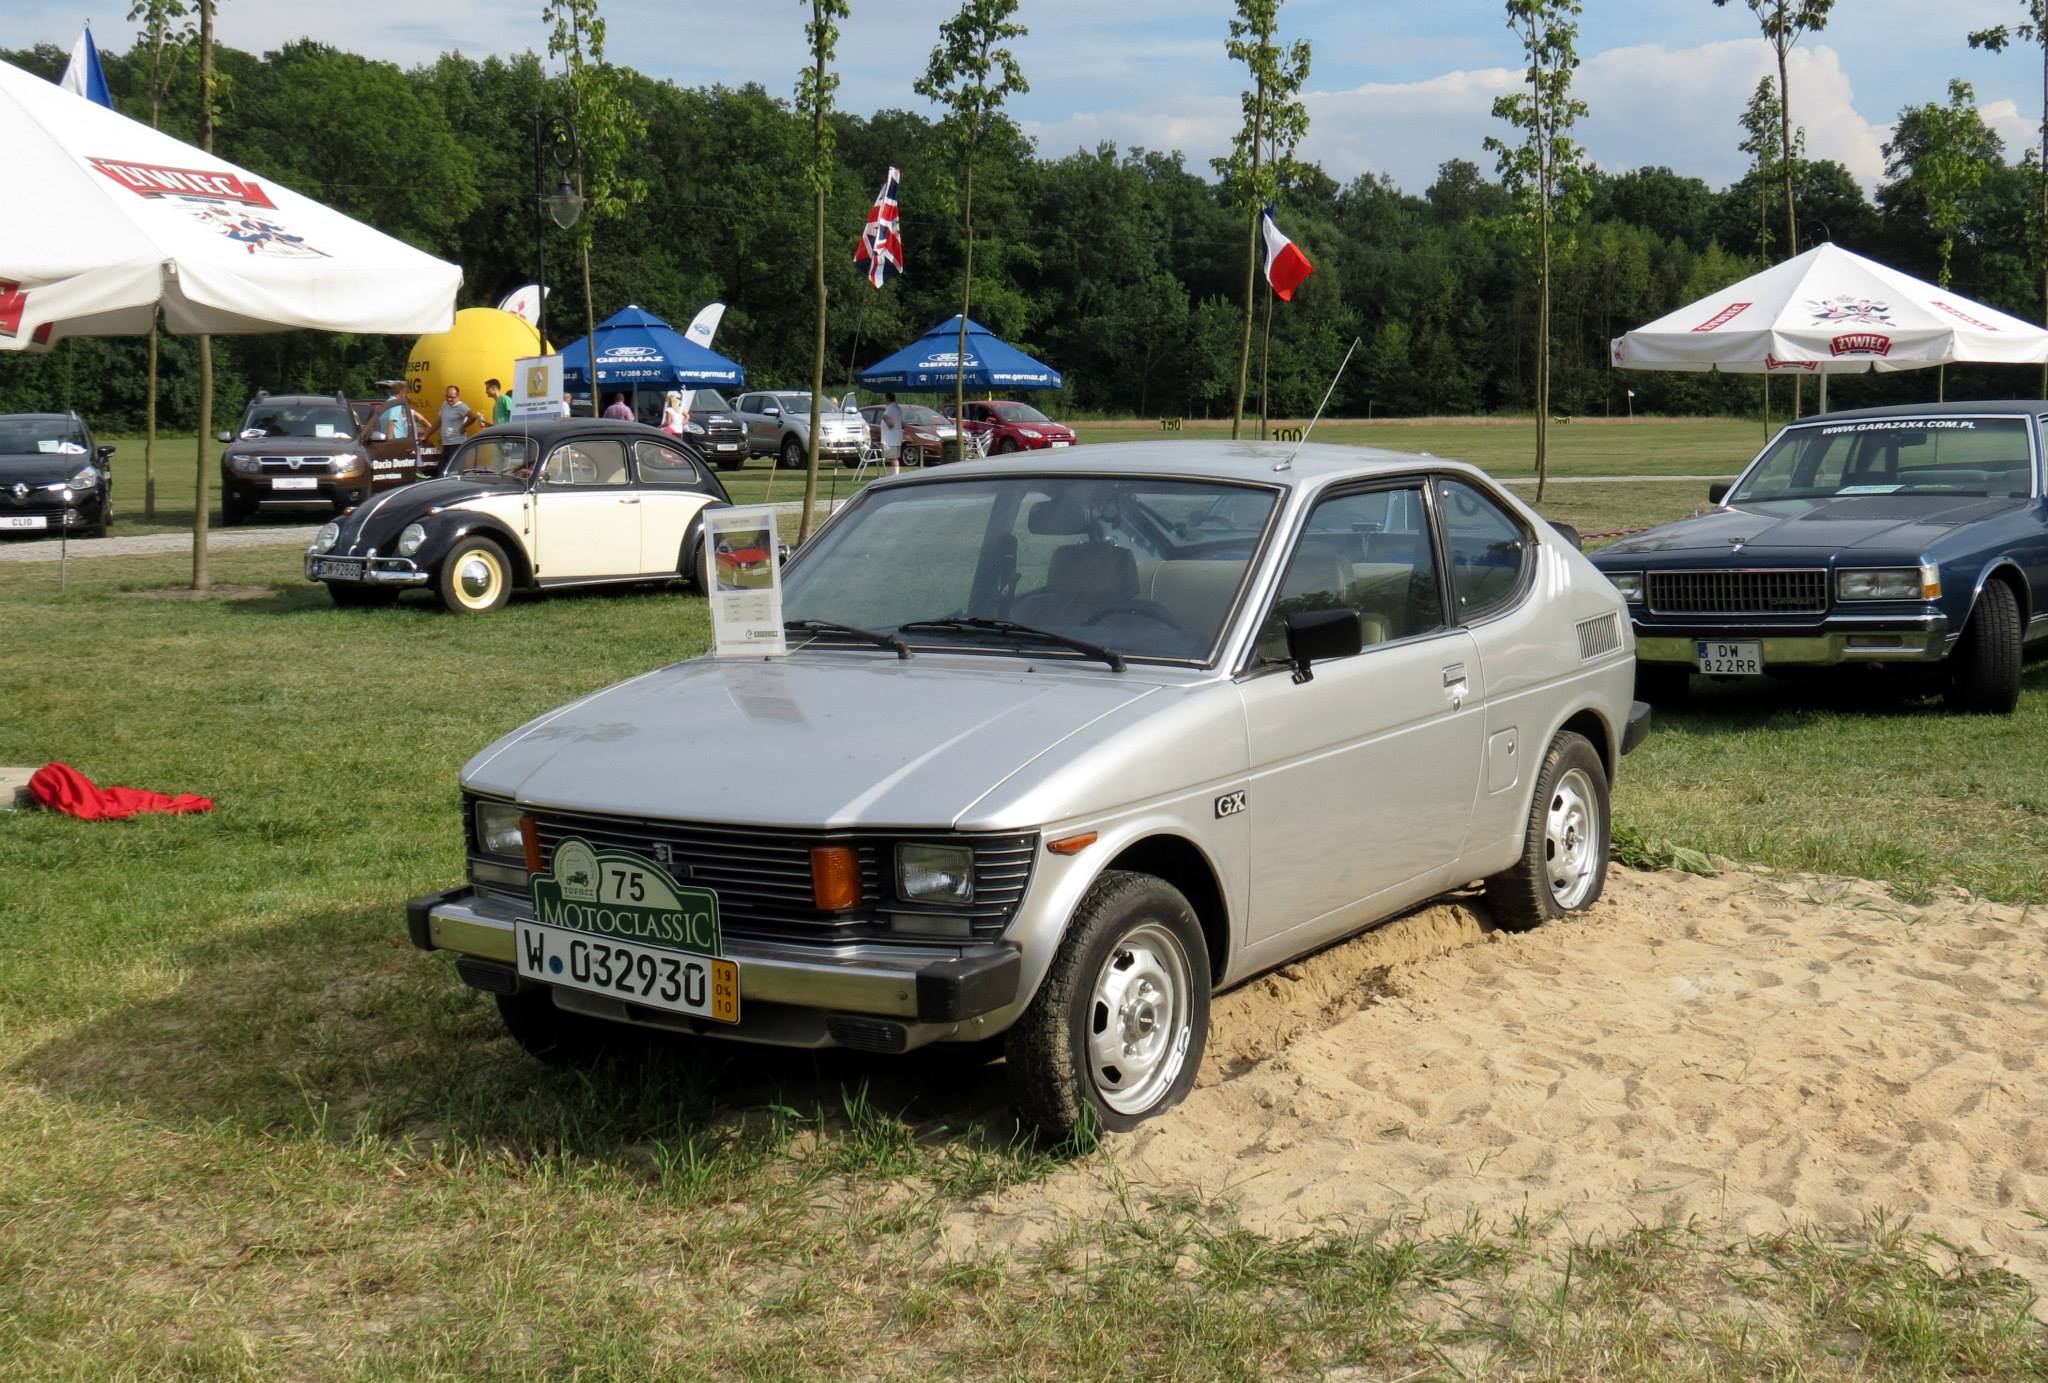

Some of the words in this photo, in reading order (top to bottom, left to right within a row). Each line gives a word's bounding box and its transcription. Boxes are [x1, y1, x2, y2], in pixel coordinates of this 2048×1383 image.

[1837, 334, 1886, 351] ŻYWIEC
[596, 355, 664, 364] GERMAZ
[679, 370, 736, 379] www.germaz.pl
[993, 373, 1048, 381] www.germaz.pl
[1822, 421, 1976, 435] WWW.GARAZ4X4.COM.PL
[1272, 429, 1302, 442] 100
[372, 459, 392, 469] Dacia
[392, 458, 416, 468] Duster
[12, 518, 33, 526] CLIO
[1718, 645, 1739, 658] DW
[1704, 659, 1757, 673] 822RR
[1217, 791, 1246, 817] GX
[611, 870, 645, 902] 75
[543, 896, 711, 948] MOTOCLASSIC
[524, 929, 544, 973] W
[570, 940, 706, 1008] 032930
[716, 967, 731, 981] 19
[716, 1000, 732, 1014] 10
